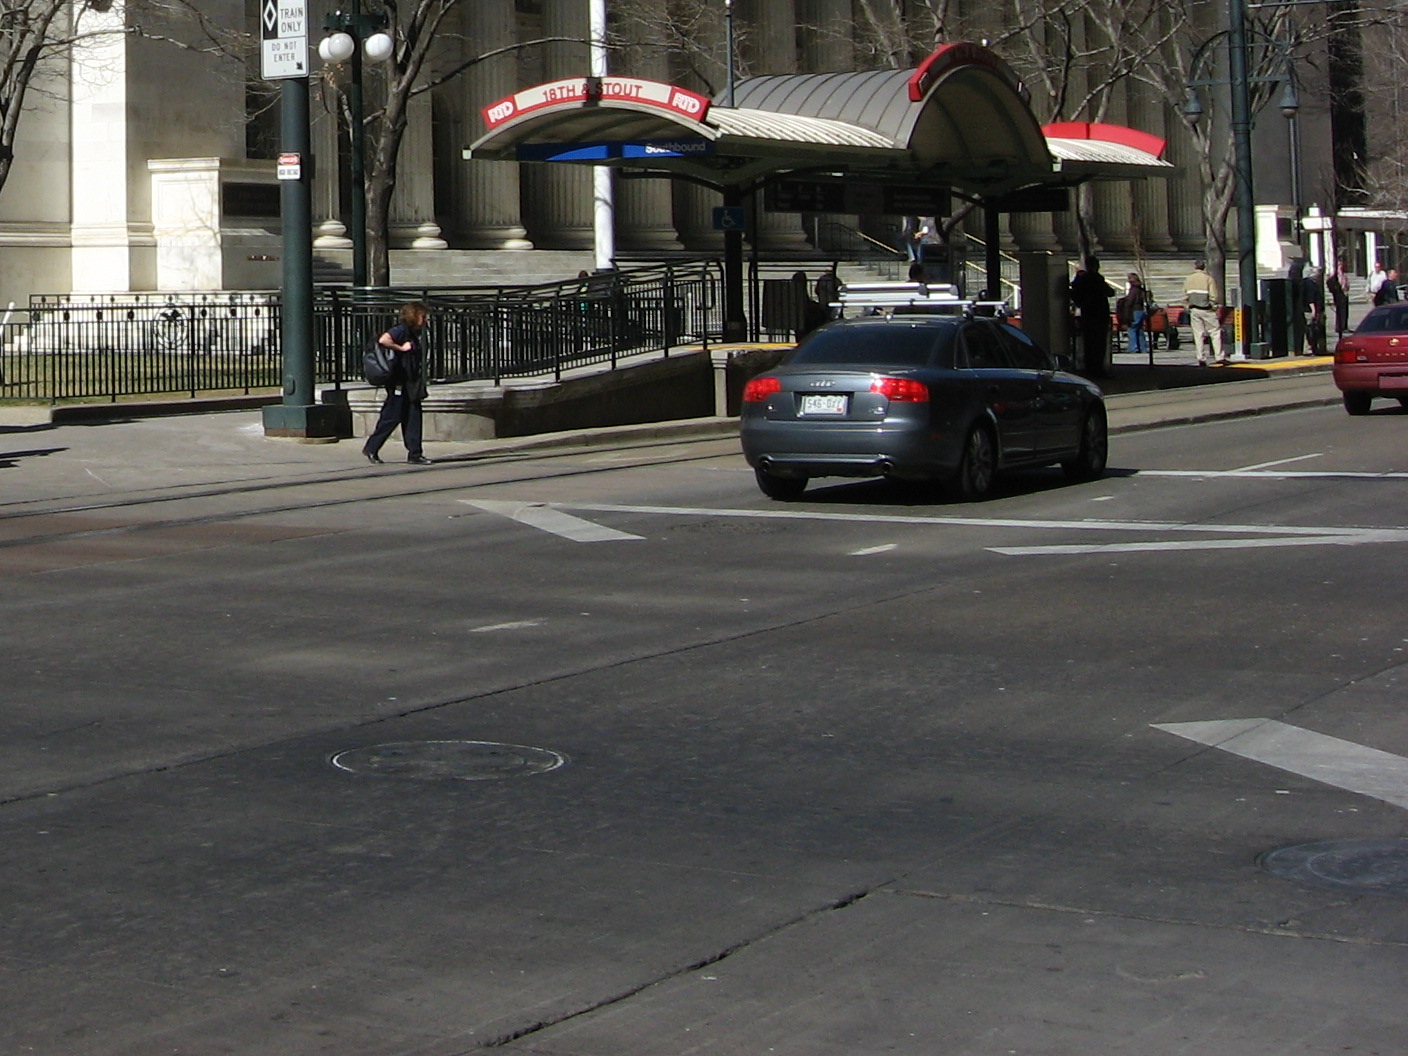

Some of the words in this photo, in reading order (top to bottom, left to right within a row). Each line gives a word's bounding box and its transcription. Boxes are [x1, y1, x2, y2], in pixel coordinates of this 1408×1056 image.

[280, 7, 304, 19] TRAIN
[281, 20, 303, 33] ONLY
[271, 43, 281, 51] DO
[284, 41, 297, 51] NOT
[274, 52, 296, 63] ENTER
[542, 84, 576, 102] 18TH
[595, 82, 643, 98] STOUT
[645, 142, 706, 154] Southbound
